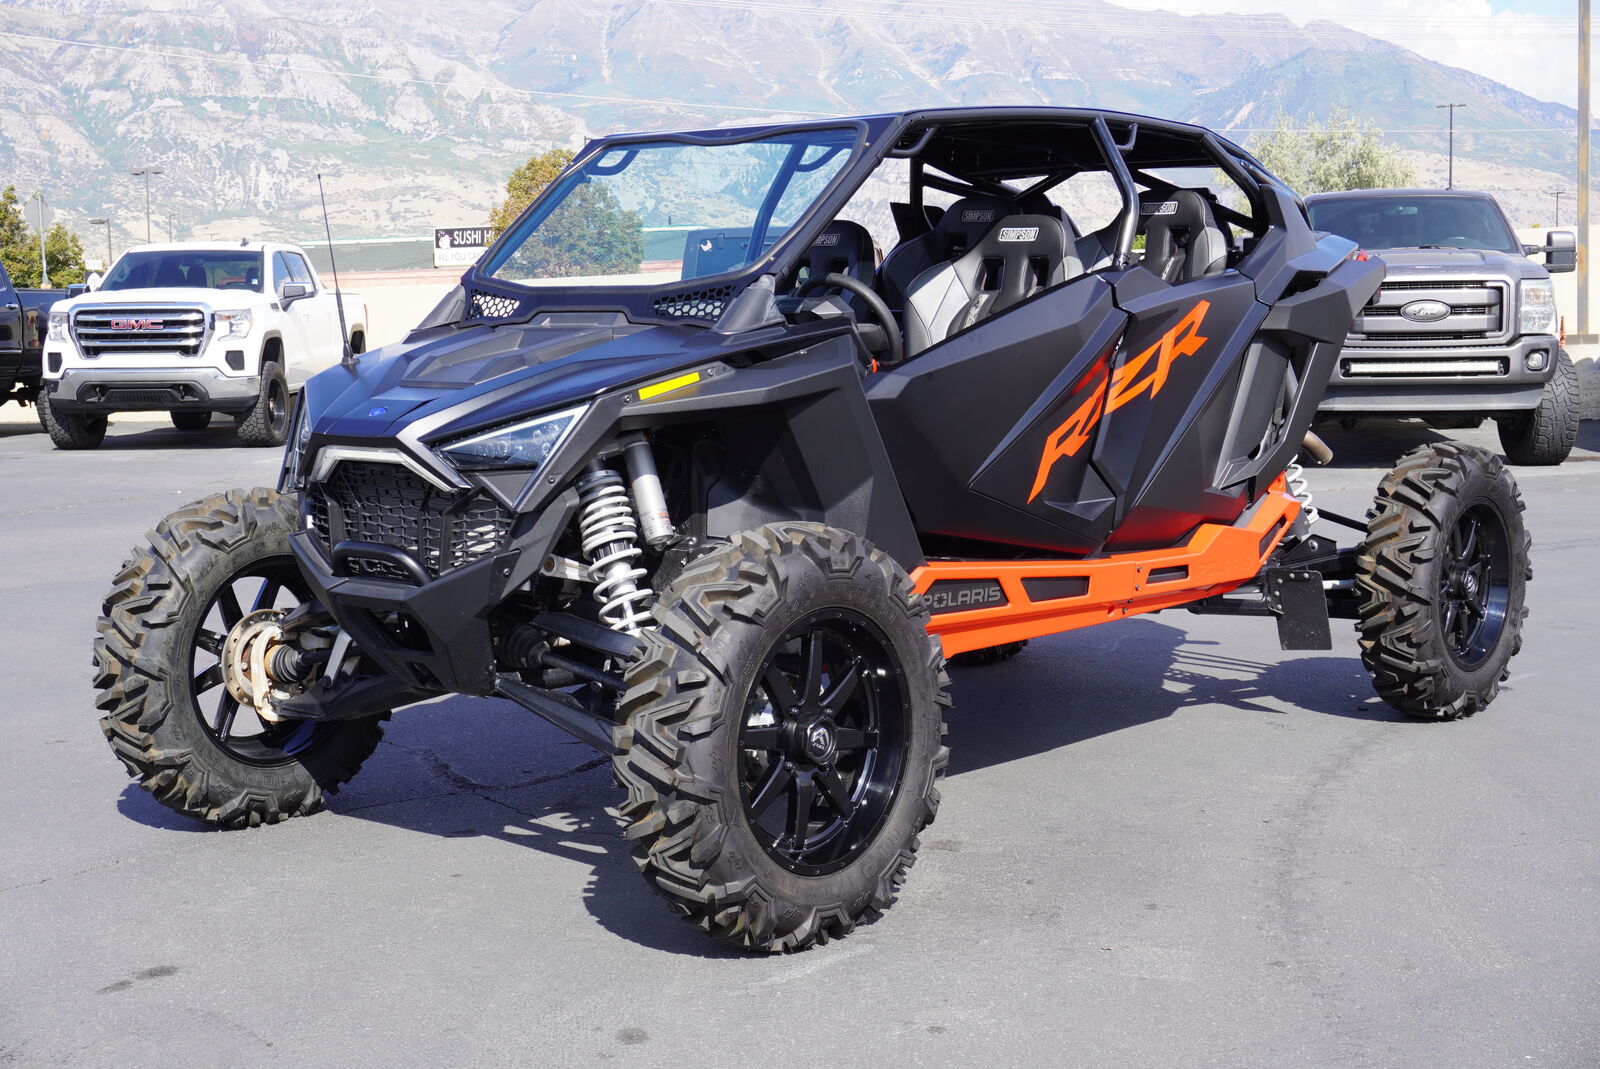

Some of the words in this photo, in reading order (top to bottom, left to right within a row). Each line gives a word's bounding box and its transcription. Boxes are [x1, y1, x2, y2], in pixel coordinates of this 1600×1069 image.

[453, 230, 481, 244] SUSHI
[1001, 230, 1036, 240] SIMPSON
[111, 319, 163, 329] GMC
[1027, 300, 1210, 504] RZR
